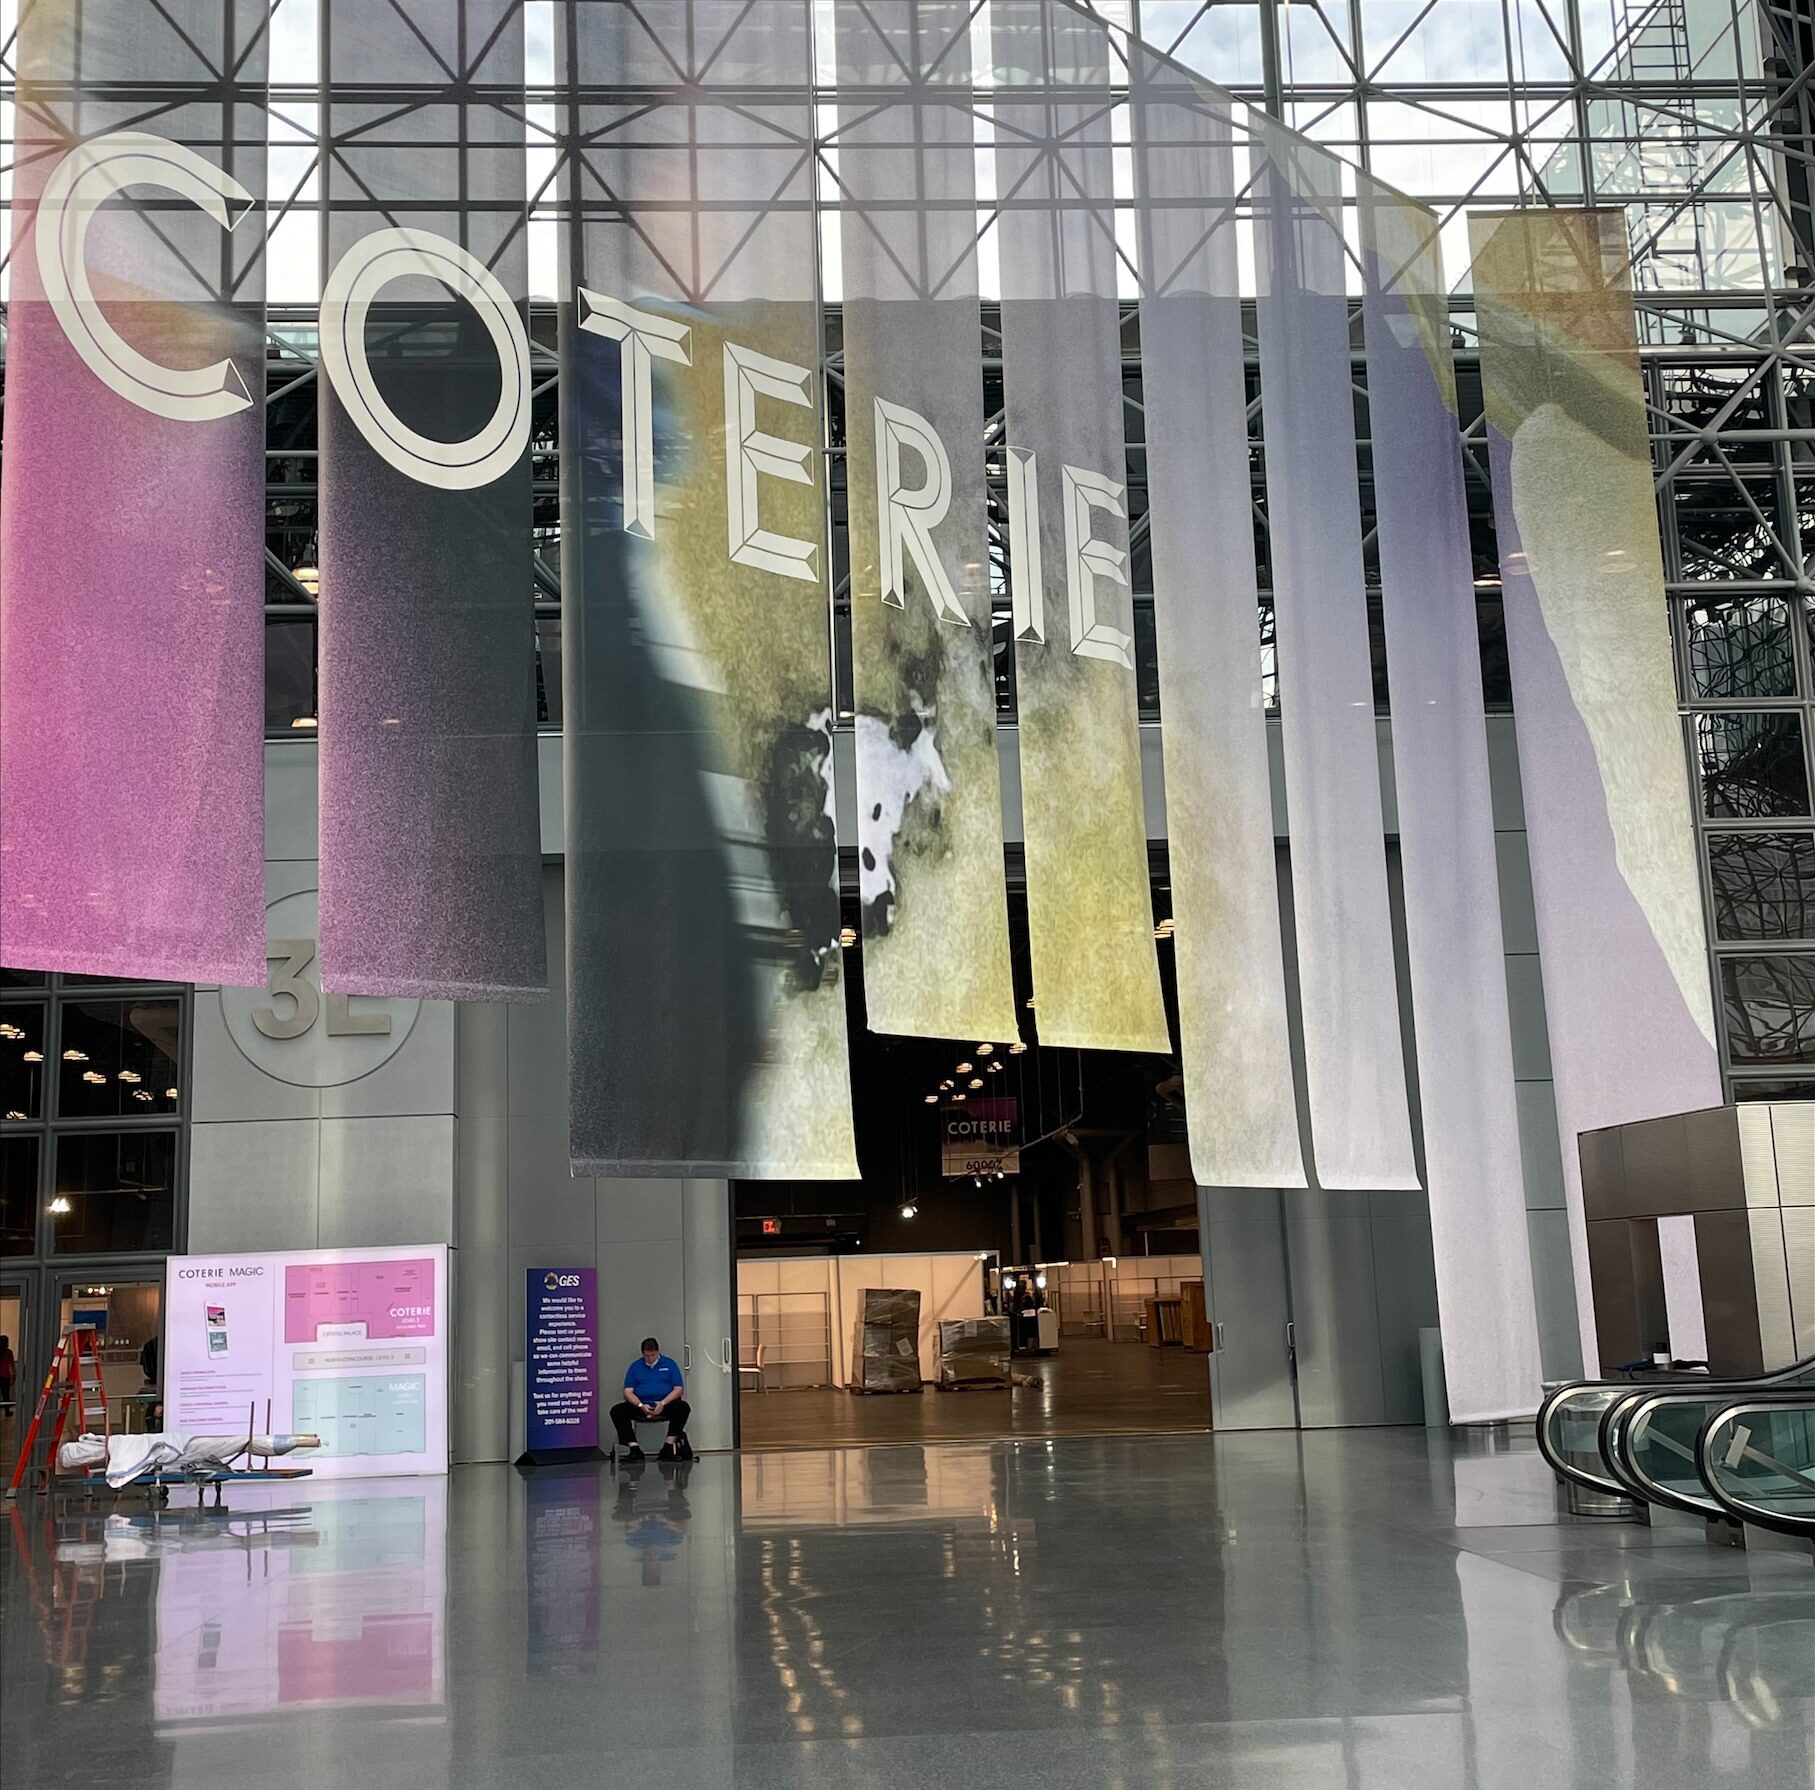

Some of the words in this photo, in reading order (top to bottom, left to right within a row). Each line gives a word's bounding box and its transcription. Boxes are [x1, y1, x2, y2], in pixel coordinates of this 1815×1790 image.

[34, 130, 1134, 671] COTERIE
[947, 1120, 1012, 1134] COTERIE
[178, 1267, 224, 1279] COTERIE
[229, 1266, 264, 1277] MAGIC
[559, 1275, 580, 1287] GES
[389, 1306, 431, 1317] COTERIE
